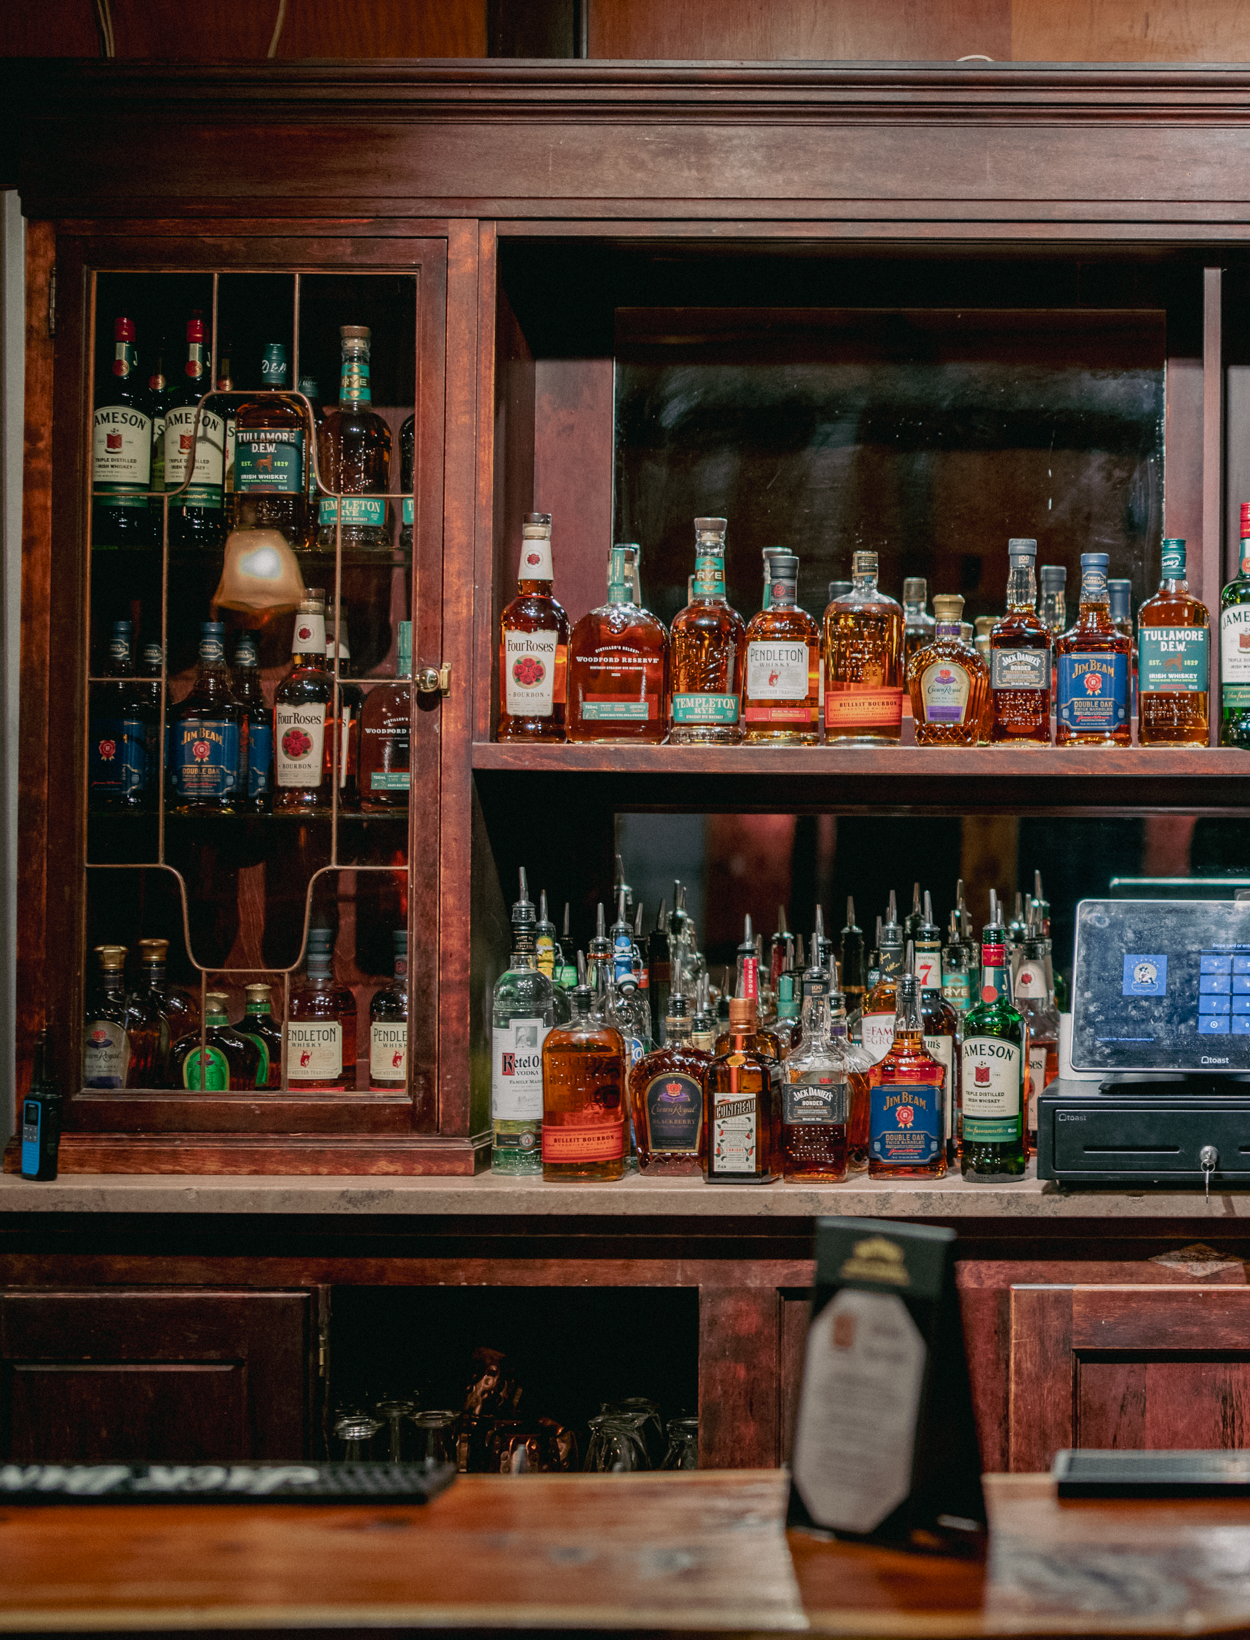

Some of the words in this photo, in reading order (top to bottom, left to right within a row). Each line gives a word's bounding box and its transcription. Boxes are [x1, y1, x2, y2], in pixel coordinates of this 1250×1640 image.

[342, 378, 366, 386] RYE
[94, 411, 147, 431] AMESON
[167, 412, 219, 431] AMEON
[237, 432, 295, 443] TULLAMORE
[251, 443, 277, 453] D.E.W.
[320, 500, 381, 513] TEMPLETON
[697, 571, 722, 580] RYE
[1143, 630, 1204, 641] TULLAMORE
[507, 639, 525, 652] Four
[525, 639, 554, 652] Roses
[1160, 641, 1187, 652] D.E.W.
[750, 648, 804, 663] PENDLETON
[1001, 654, 1017, 666] JACK
[1016, 652, 1041, 667] DANIEL'S
[1072, 663, 1089, 679] JIM
[1090, 659, 1115, 678] BEAM
[675, 697, 736, 710] TEMPLETON
[277, 712, 293, 725] Four
[293, 712, 322, 725] Roses
[181, 731, 198, 745] JIM
[199, 727, 223, 745] BEAM
[919, 964, 933, 986] 7
[944, 988, 968, 996] RYE
[287, 1027, 336, 1042] ENDLETON
[373, 1027, 407, 1042] PENDLE
[871, 1027, 894, 1036] FAM
[871, 1036, 895, 1045] GRO
[963, 1044, 1015, 1061] AMESON
[503, 1054, 531, 1074] Ketel
[1209, 1056, 1229, 1064] toast
[793, 1088, 808, 1101] JACK
[808, 1086, 833, 1102] DANIEL'S
[883, 1094, 900, 1111] JIM
[901, 1091, 926, 1110] BEAM
[651, 1104, 674, 1115] Crown
[670, 1103, 697, 1116] Royal
[716, 1099, 756, 1118] COINTREAU
[1067, 1114, 1087, 1122] toast
